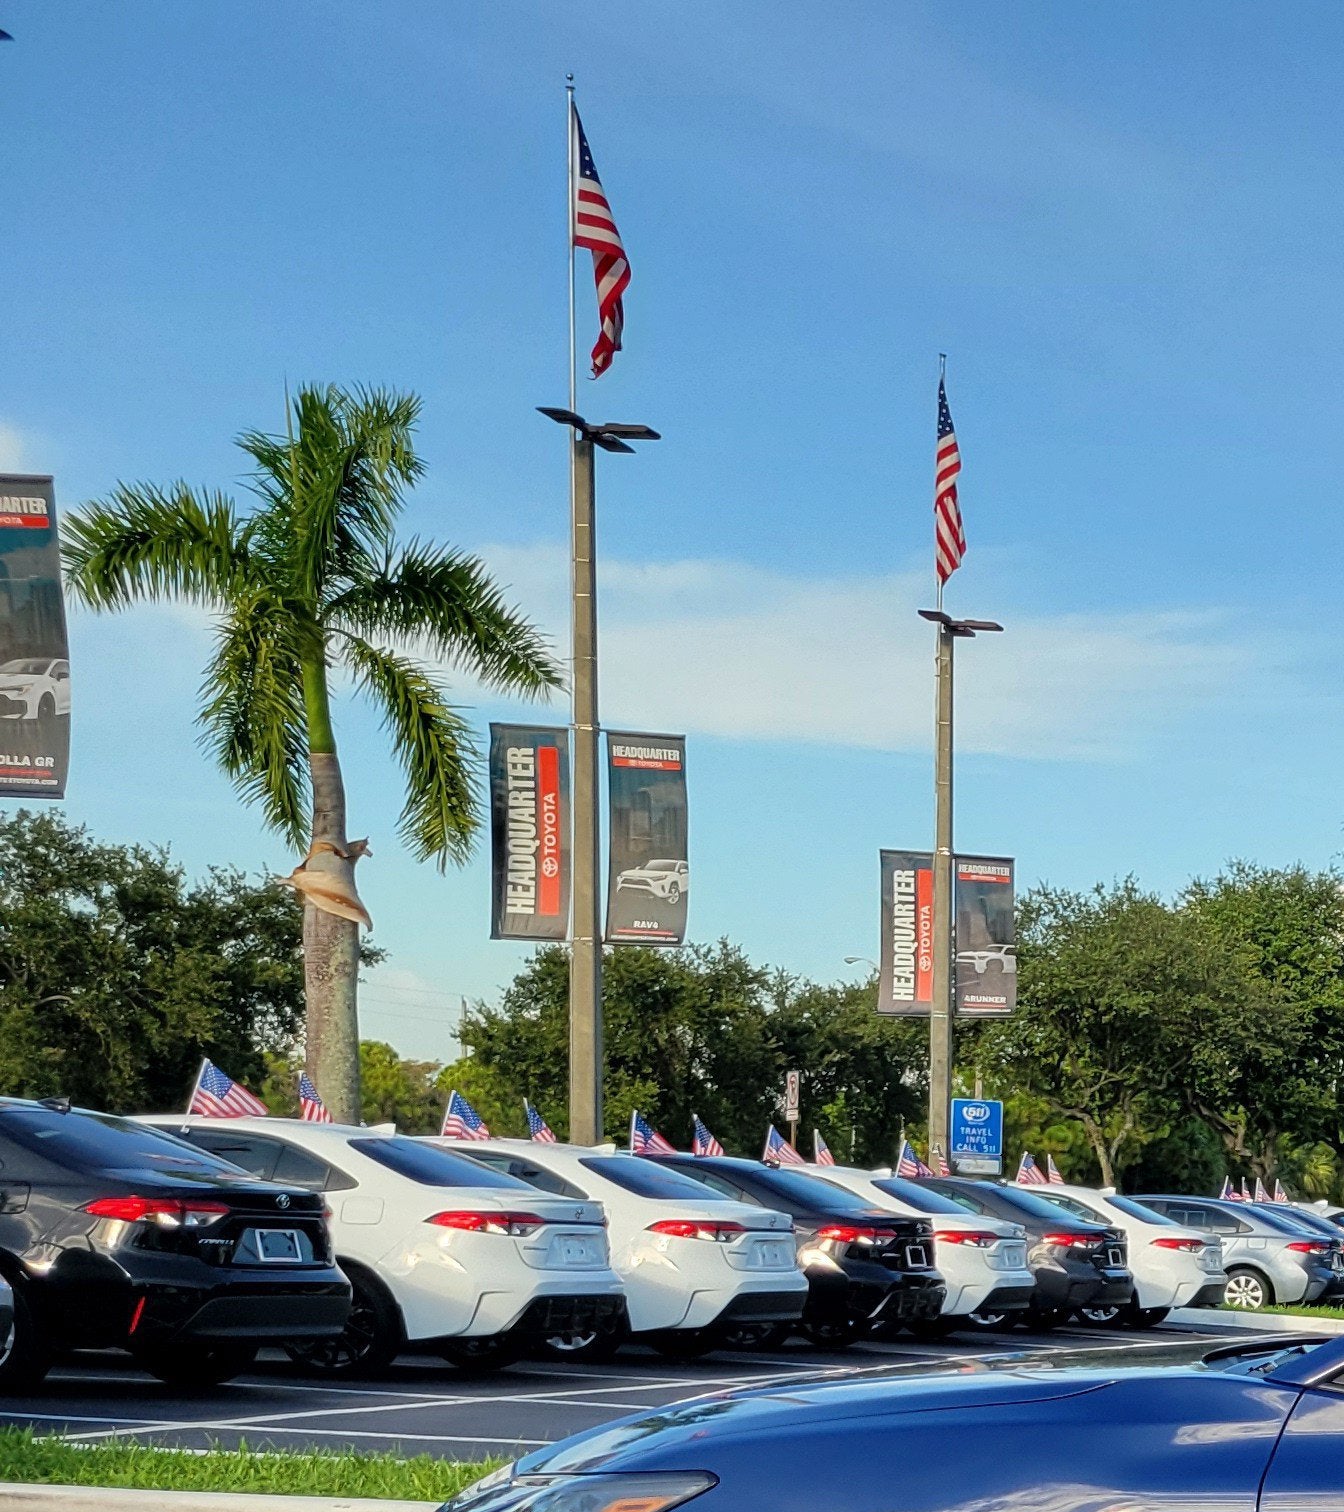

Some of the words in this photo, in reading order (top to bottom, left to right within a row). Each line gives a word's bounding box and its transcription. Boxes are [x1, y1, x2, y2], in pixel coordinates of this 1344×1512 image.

[0, 496, 48, 515] ARTER
[613, 745, 680, 761] HEADQUARTER
[34, 756, 55, 768] GR
[506, 747, 540, 915] HEADQUARTER
[543, 793, 557, 856] TOYOTA
[958, 863, 1010, 877] HEADQUARTER
[633, 920, 659, 929] RAV4
[920, 905, 931, 953] TOYOTA
[892, 869, 918, 1001] HEADQUARTER
[968, 1107, 985, 1118] 511
[960, 1126, 994, 1137] TRAVEL
[965, 1135, 987, 1144] INFO
[956, 1143, 979, 1153] CALL
[983, 1144, 996, 1153] 511
